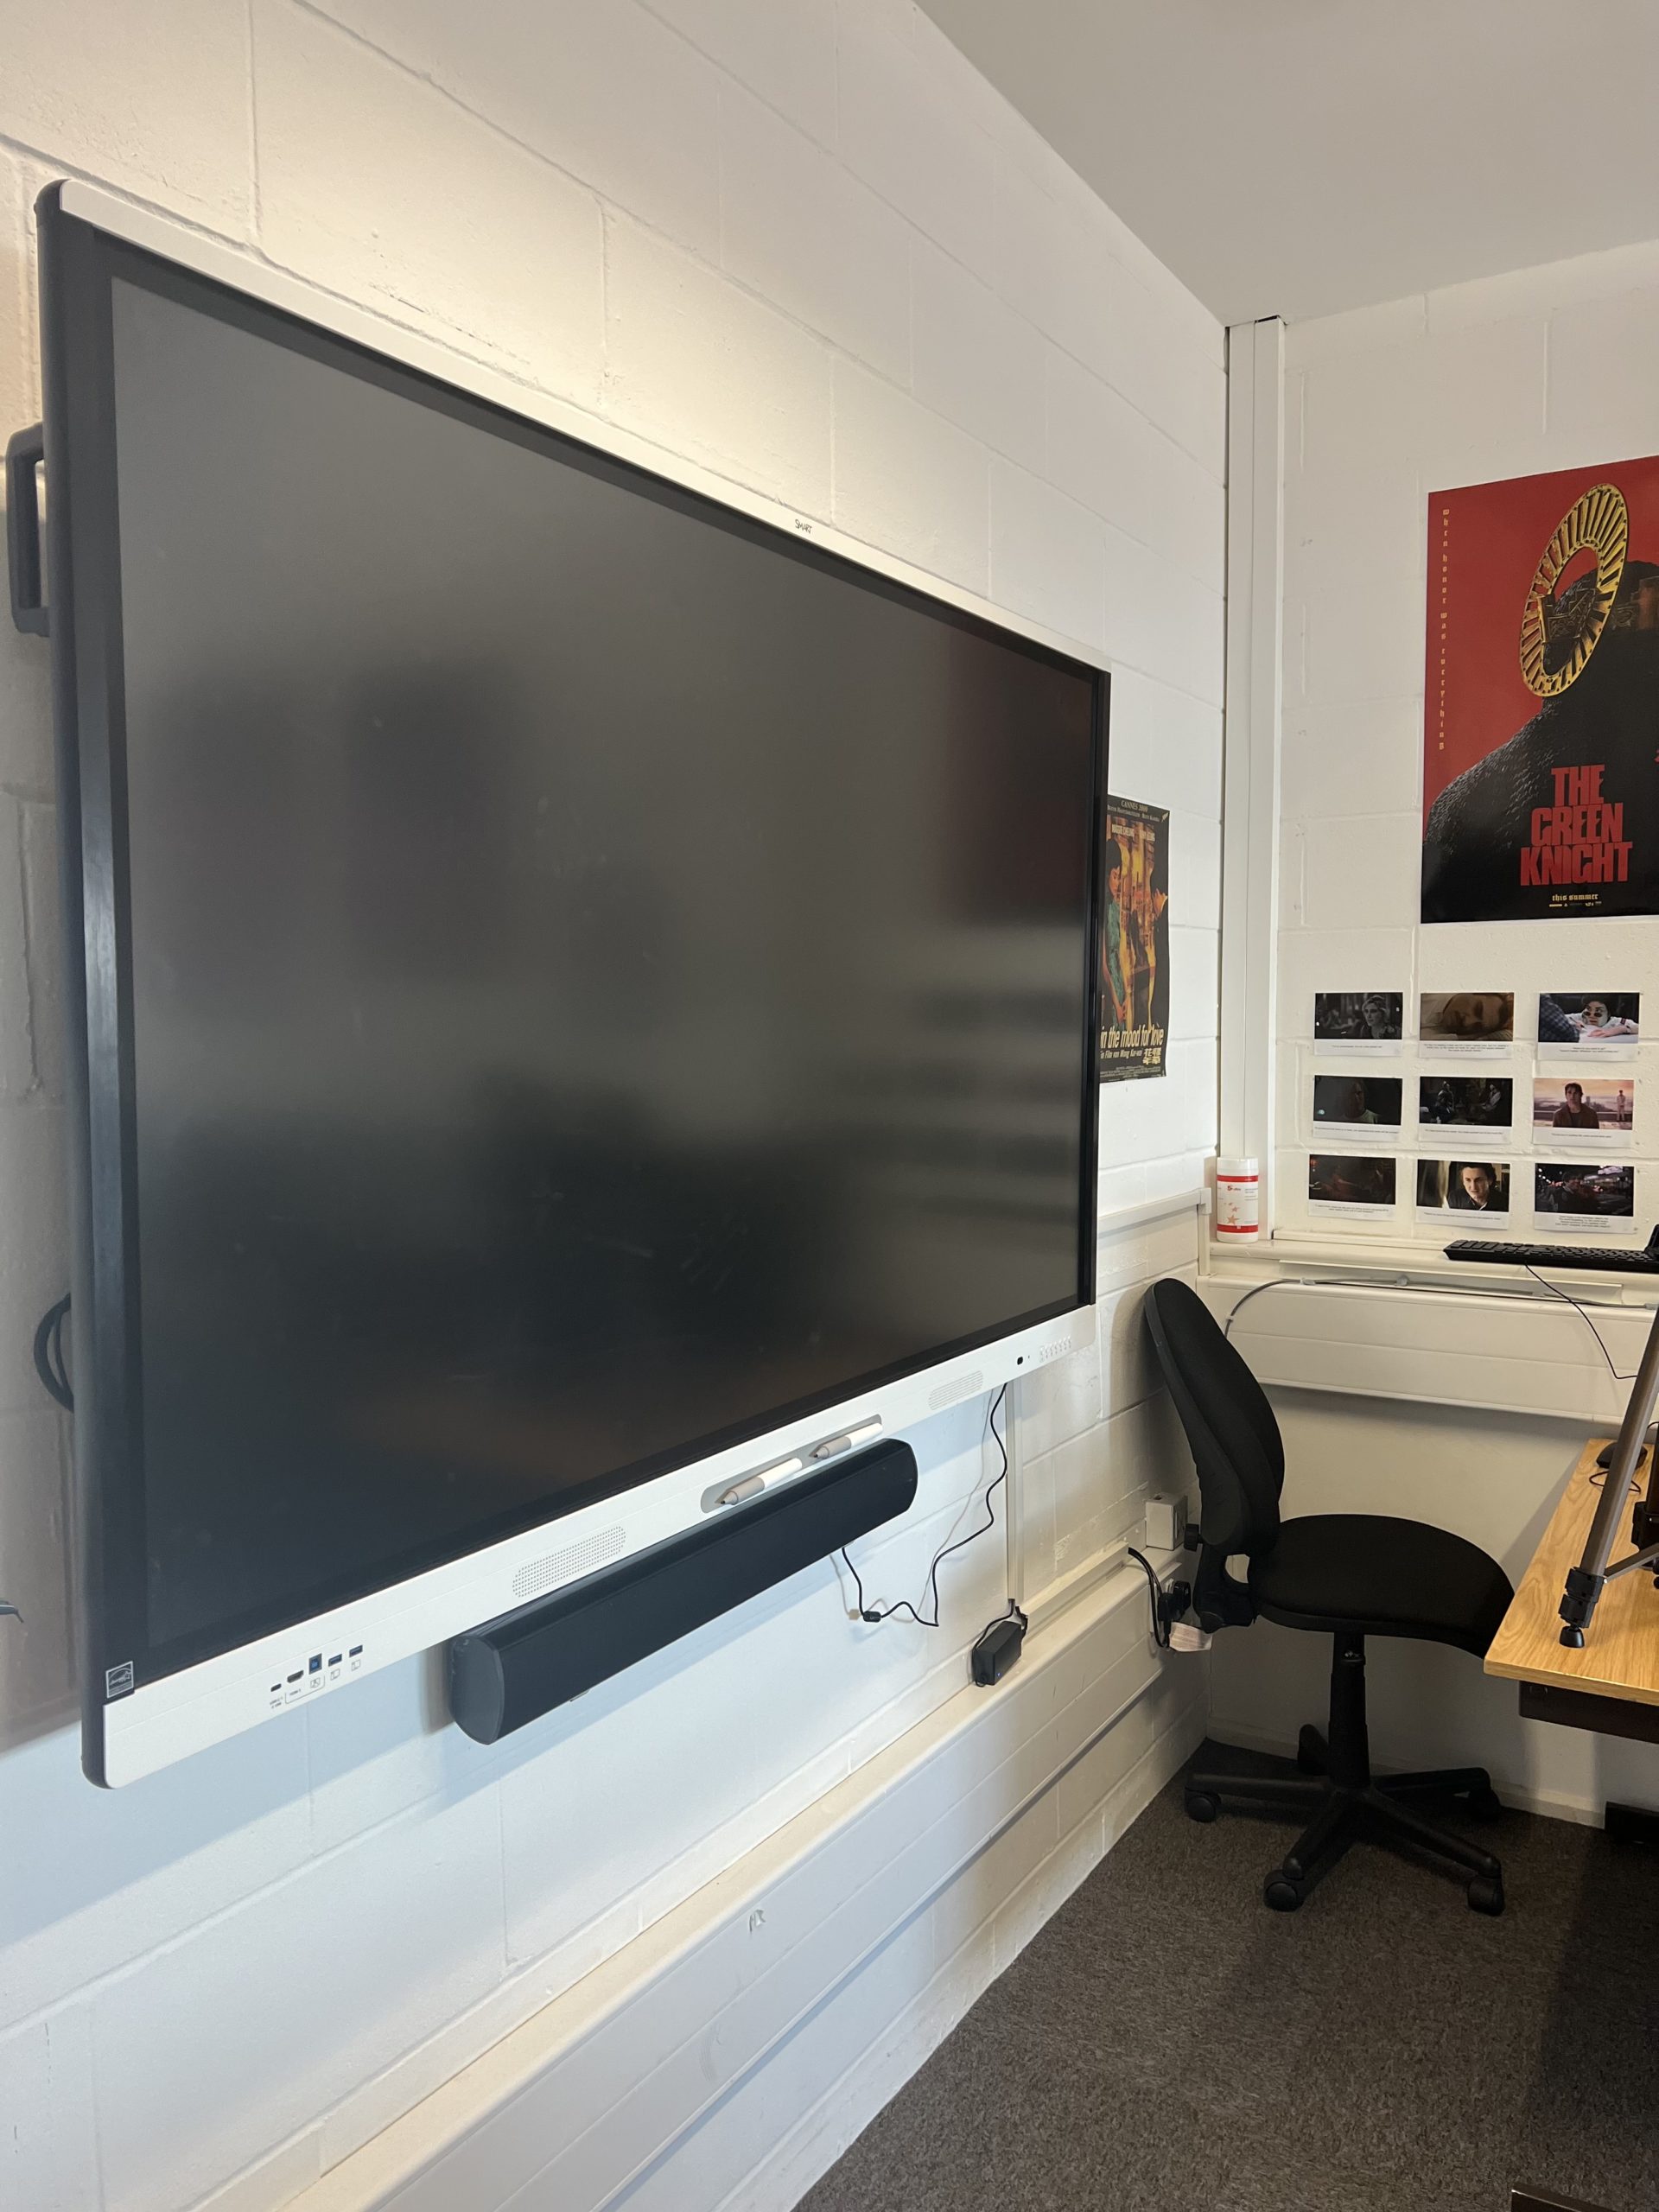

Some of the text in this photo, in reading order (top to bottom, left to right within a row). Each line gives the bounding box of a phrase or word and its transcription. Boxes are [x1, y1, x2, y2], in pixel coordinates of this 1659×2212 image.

[794, 518, 813, 534] SMART
[1551, 764, 1605, 807] THE
[1531, 802, 1624, 847] GREEN
[1520, 842, 1633, 887] KNIGHT
[1100, 1023, 1164, 1048] in the mood for love
